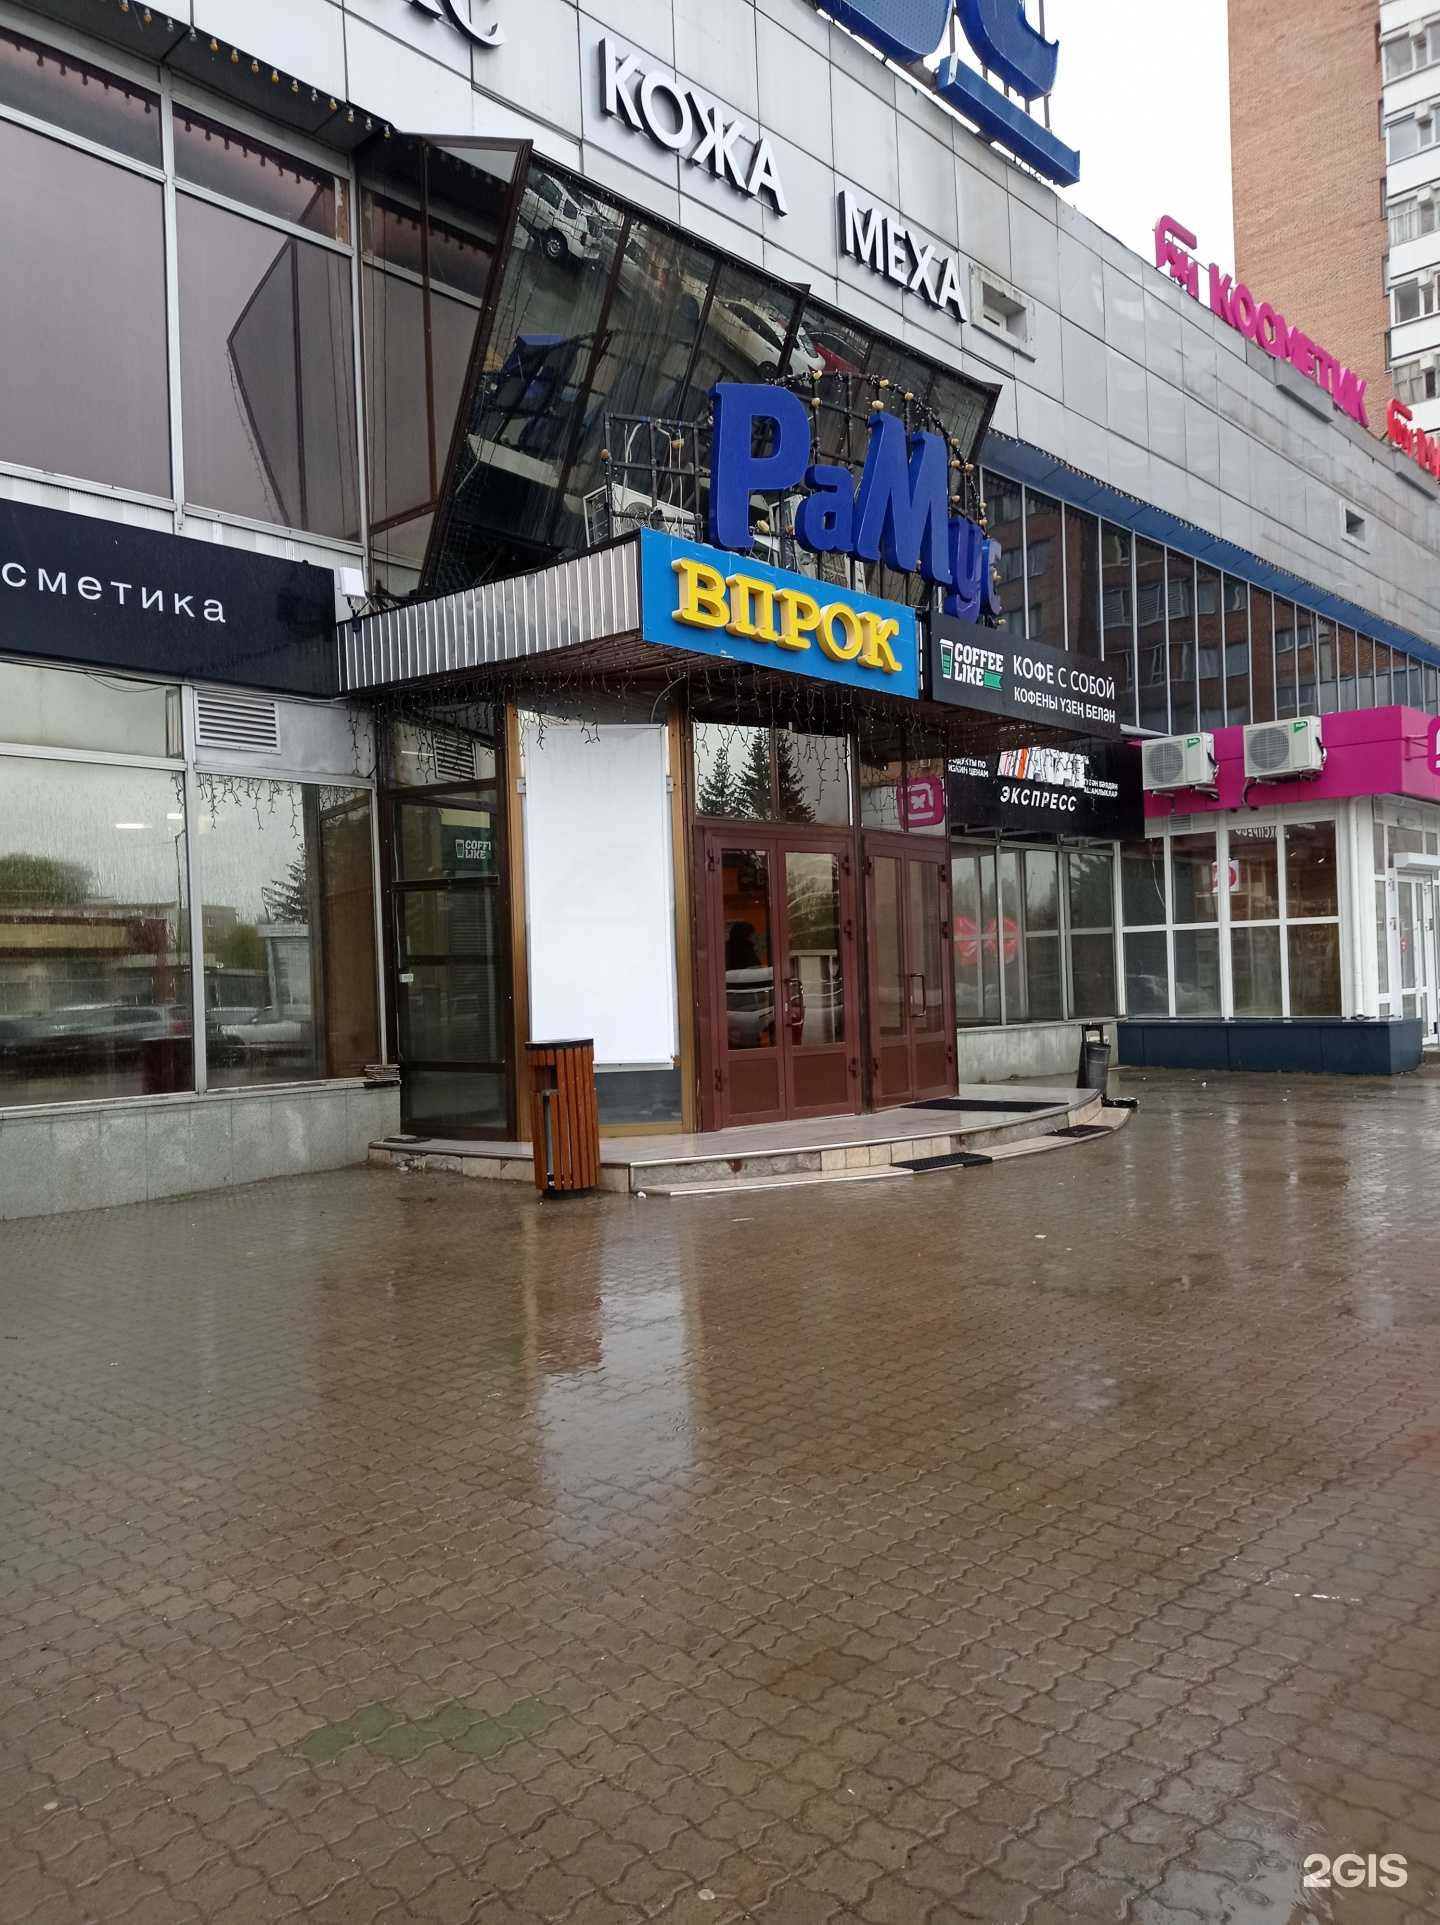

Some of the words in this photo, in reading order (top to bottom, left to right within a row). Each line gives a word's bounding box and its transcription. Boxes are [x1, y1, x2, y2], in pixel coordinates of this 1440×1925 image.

[599, 38, 788, 217] КОЖА
[838, 190, 969, 324] МЕХА
[1, 562, 226, 624] сметика
[671, 558, 903, 674] ВПРОК
[954, 642, 1004, 672] COFFEE
[954, 662, 984, 687] LIKE
[1013, 654, 1055, 685] КОФЕ
[1058, 667, 1067, 688] С
[1070, 670, 1115, 700] СОБОЙ
[1014, 686, 1058, 711] КОФЕНЫ
[1000, 786, 1078, 812] ЭКСПРЕСС
[465, 849, 487, 859] LIKE
